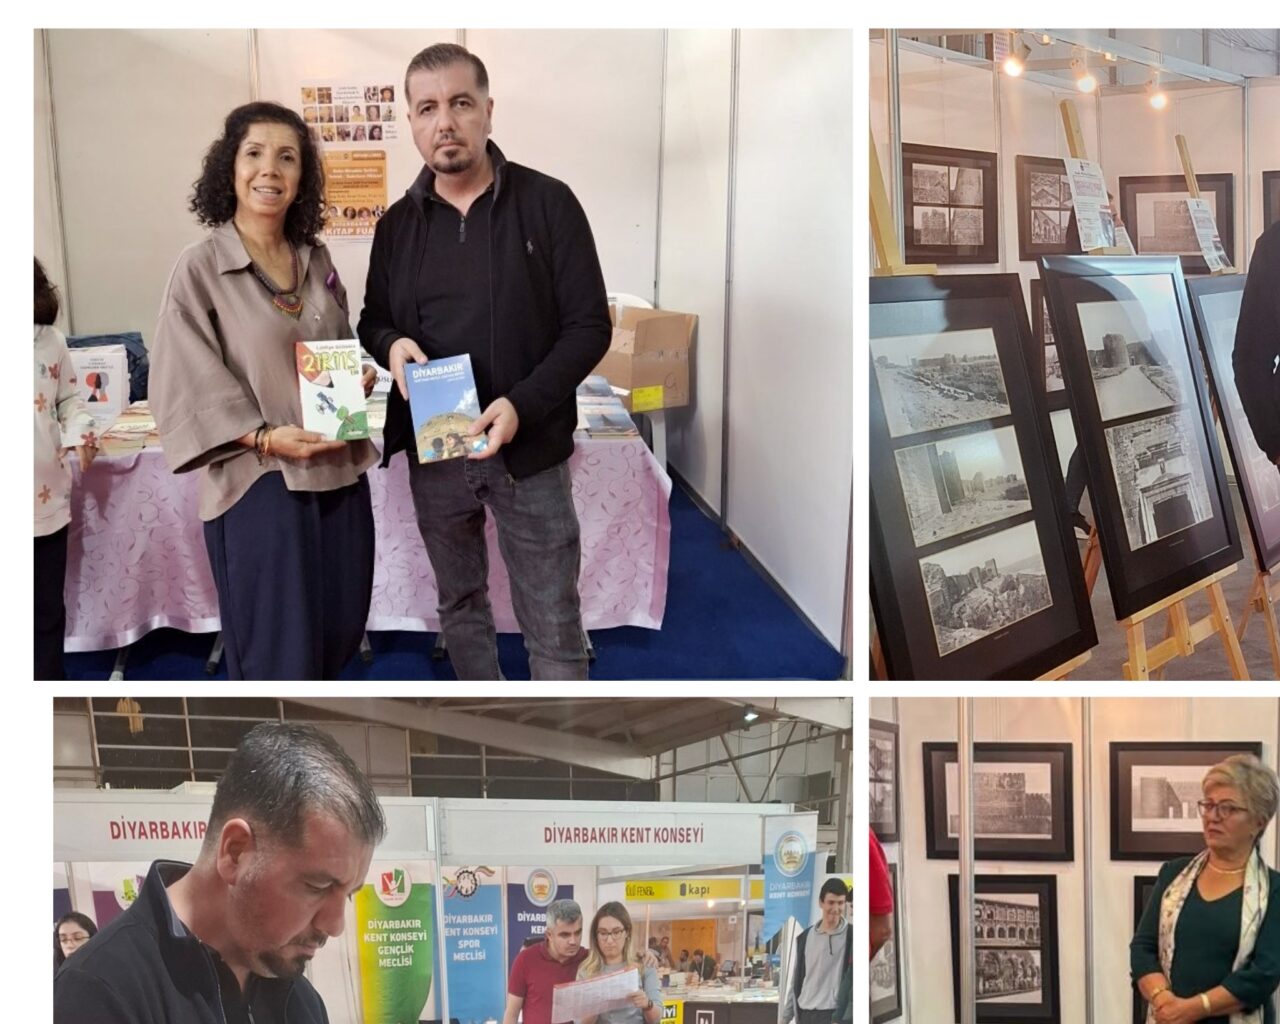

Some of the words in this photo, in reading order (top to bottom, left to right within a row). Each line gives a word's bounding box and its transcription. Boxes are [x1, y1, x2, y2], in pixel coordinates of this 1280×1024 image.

[413, 362, 464, 379] DİYARBAKIR
[109, 815, 206, 840] DİYARBAKIR
[544, 821, 618, 843] DİYARBAKIR
[621, 827, 651, 843] KENT
[653, 823, 704, 843] KONSEYİ
[689, 884, 710, 897] kapı
[444, 914, 493, 924] DİYARBAKIR
[517, 911, 547, 922] DİYARB
[368, 918, 421, 930] DİYARBAKIR
[531, 925, 547, 934] KEN
[364, 933, 387, 942] KENT
[390, 929, 427, 942] KONSEYİ
[443, 927, 462, 936] ENT
[463, 925, 498, 935] KONSEYİ
[378, 944, 414, 955] GENÇLİK
[458, 940, 480, 948] SPOR
[453, 951, 486, 961] MECLİSİ
[379, 957, 412, 967] MECLİSİ
